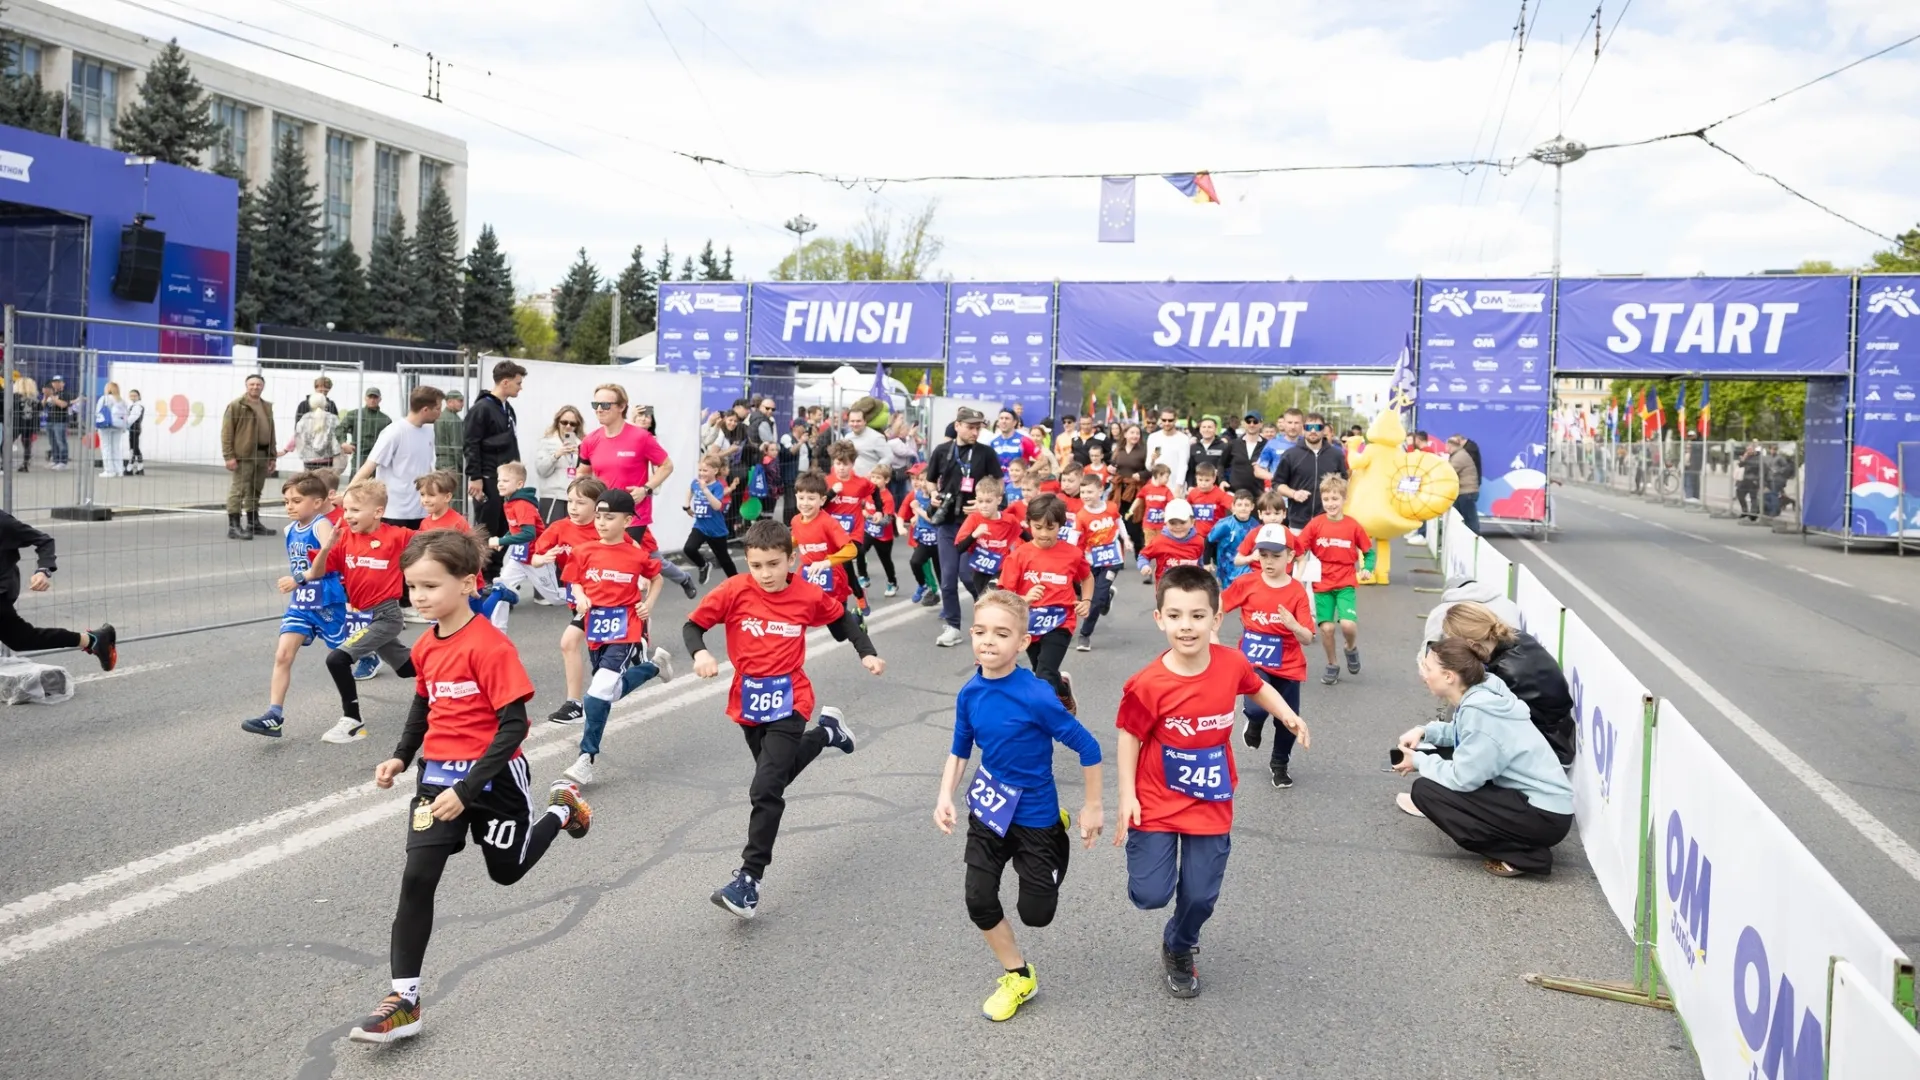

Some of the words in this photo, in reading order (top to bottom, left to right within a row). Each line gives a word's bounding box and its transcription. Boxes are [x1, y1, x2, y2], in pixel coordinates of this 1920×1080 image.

[1480, 295, 1503, 304] OM
[782, 300, 913, 344] FINISH
[1153, 301, 1309, 348] START
[1606, 302, 1799, 354] START
[695, 505, 708, 514] 221
[1089, 516, 1114, 532] OM
[1230, 530, 1237, 543] 1
[975, 555, 997, 569] 208
[295, 588, 316, 603] 143
[592, 617, 621, 634] 236
[1034, 614, 1059, 628] 281
[1247, 643, 1276, 659] 277
[749, 690, 783, 711] 266
[1201, 719, 1217, 727] OM
[1178, 765, 1221, 788] 245
[970, 778, 1007, 813] 237
[484, 818, 517, 849] 10
[1666, 809, 1711, 964] OM
[1670, 914, 1696, 970] Junior
